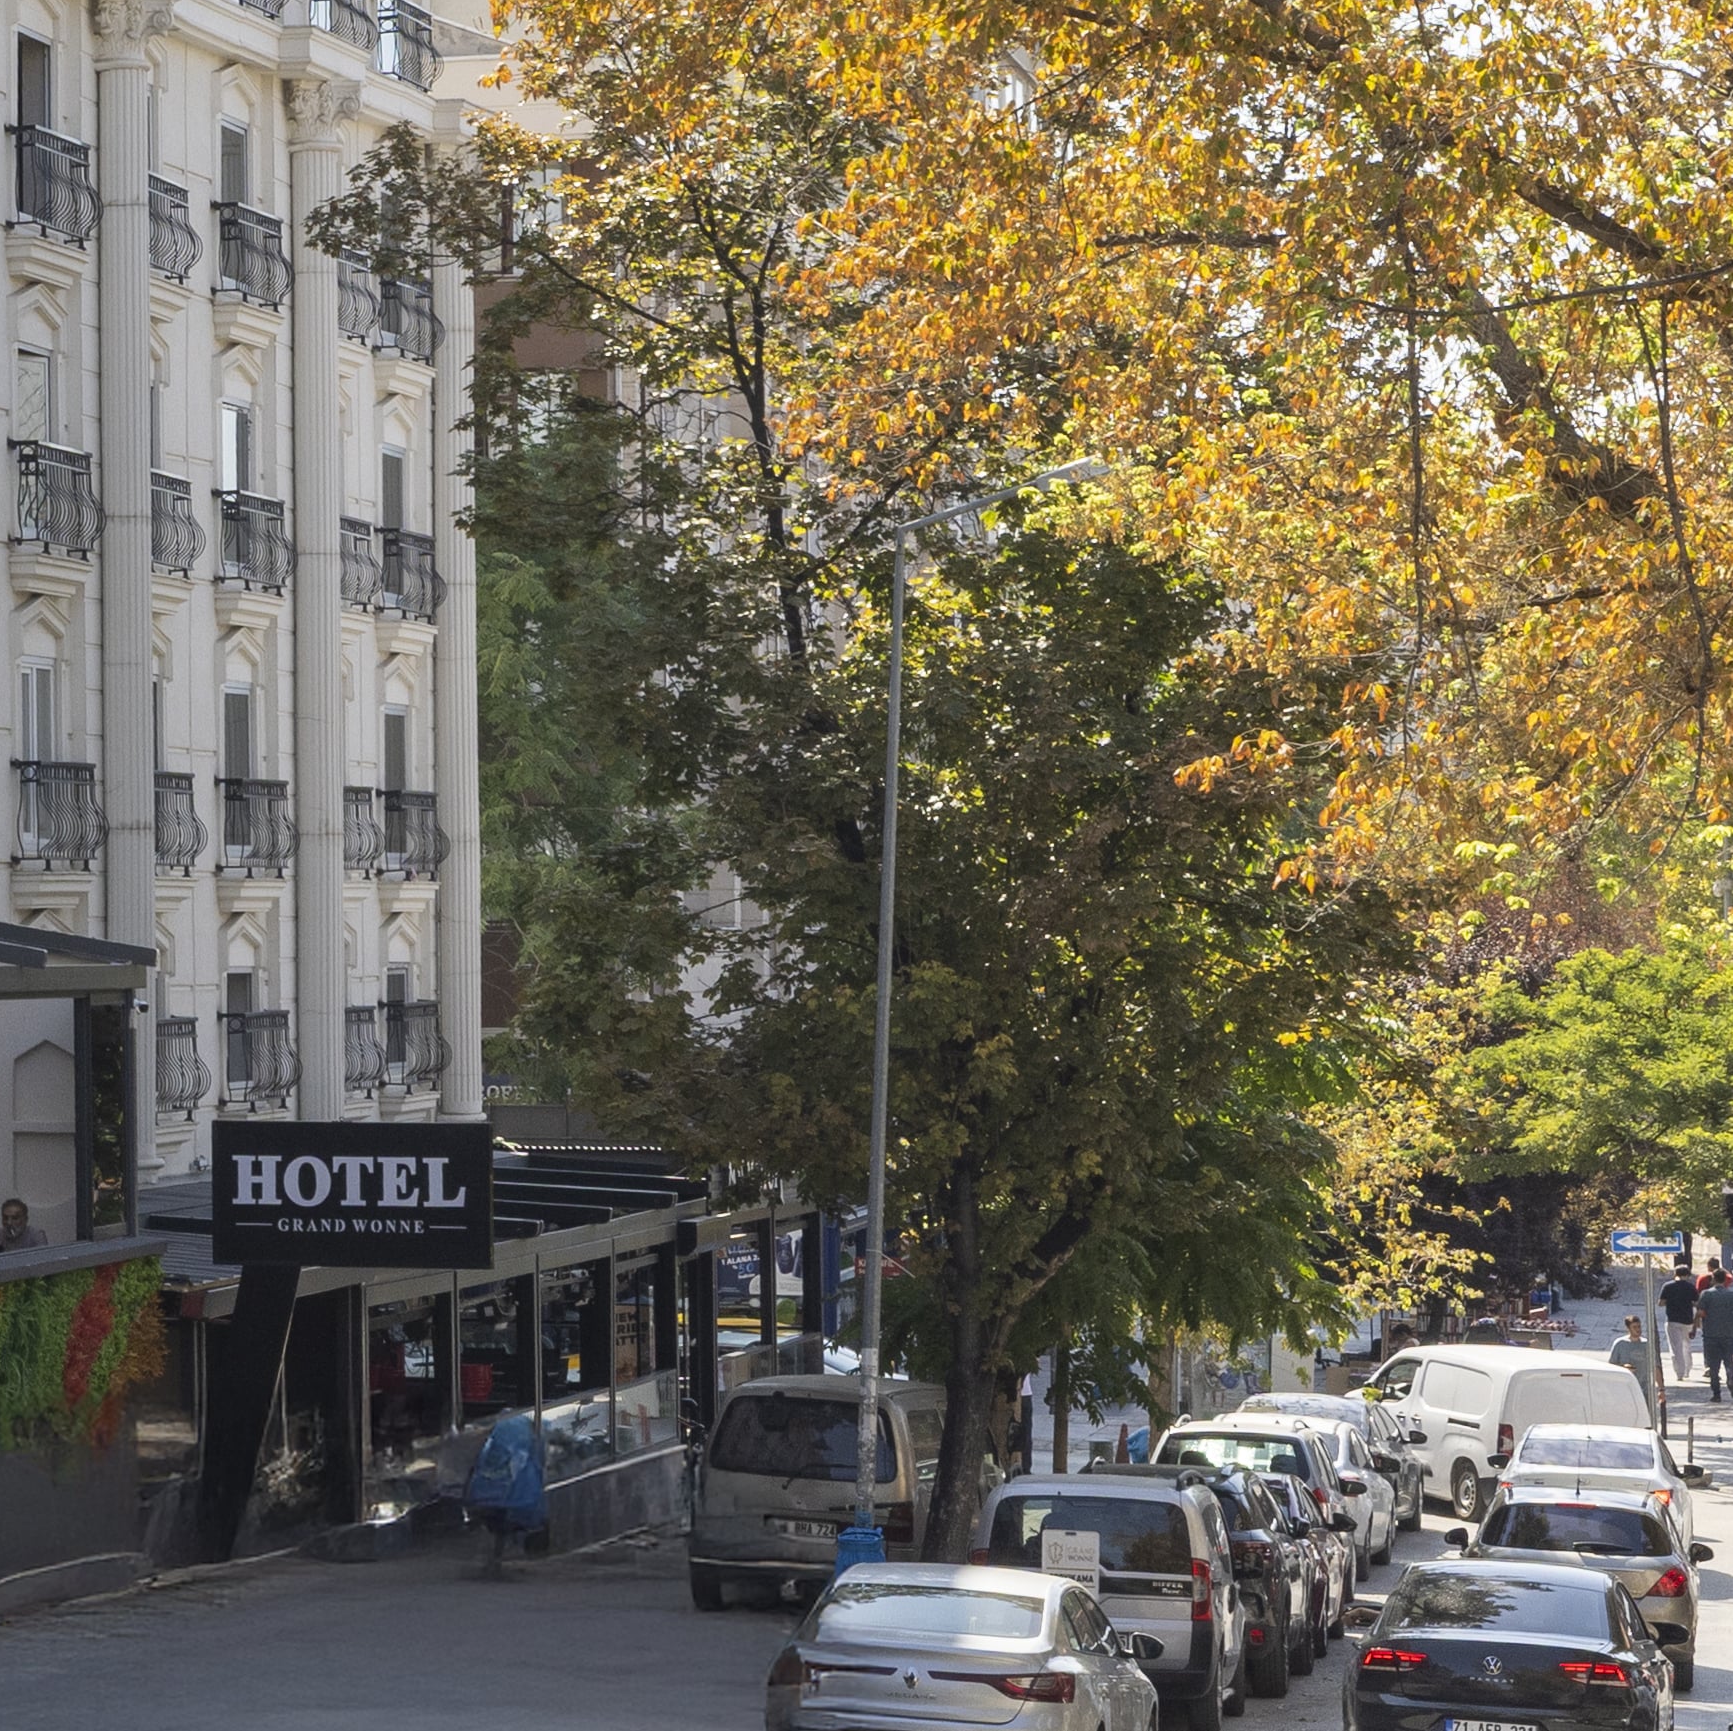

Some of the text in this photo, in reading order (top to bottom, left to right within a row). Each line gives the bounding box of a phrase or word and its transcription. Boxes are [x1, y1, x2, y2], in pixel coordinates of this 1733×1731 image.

[231, 1154, 468, 1208] HOTEL
[277, 1217, 425, 1235] GRAND WONNE
